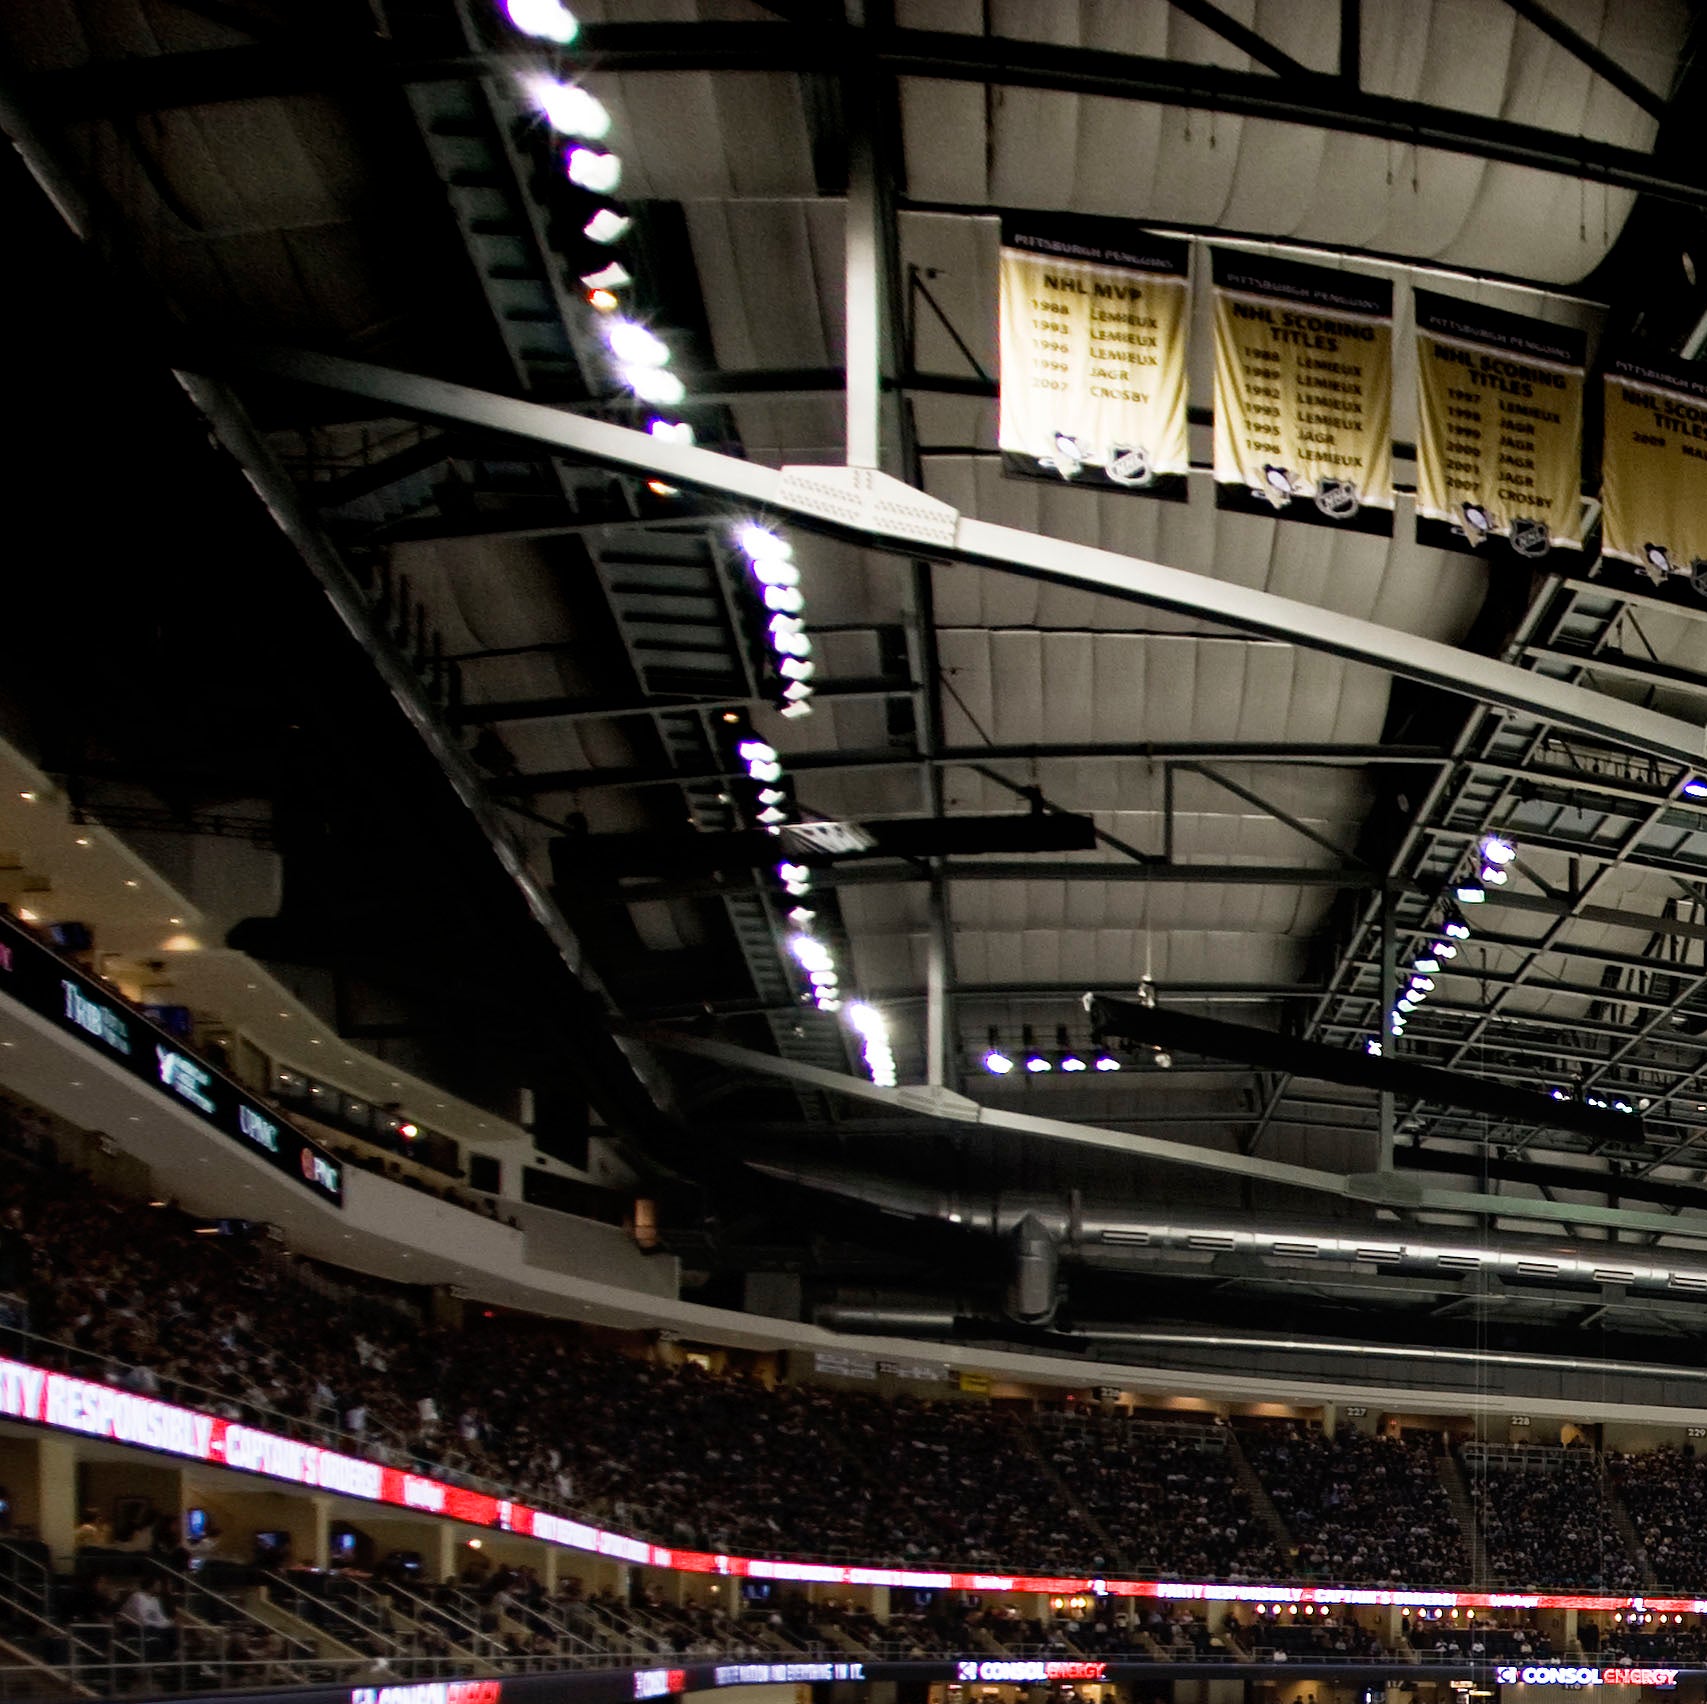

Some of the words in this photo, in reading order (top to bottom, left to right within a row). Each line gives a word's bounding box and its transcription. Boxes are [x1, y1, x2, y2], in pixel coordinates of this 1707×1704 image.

[1044, 275, 1087, 294] NHL
[1093, 282, 1142, 299] MVP
[1233, 303, 1275, 324] NHL
[1282, 312, 1375, 341] SCORING
[1271, 327, 1338, 352] TITLES
[1090, 347, 1157, 365] LEMIEUX
[1434, 345, 1475, 365] NHL
[1481, 356, 1567, 389] SCORING
[1468, 369, 1534, 398] TITLES
[1622, 388, 1660, 410] NHL
[1498, 489, 1552, 508] CROSBY
[980, 1662, 1047, 1680] CONSOL
[1523, 1668, 1602, 1684] CONSOL
